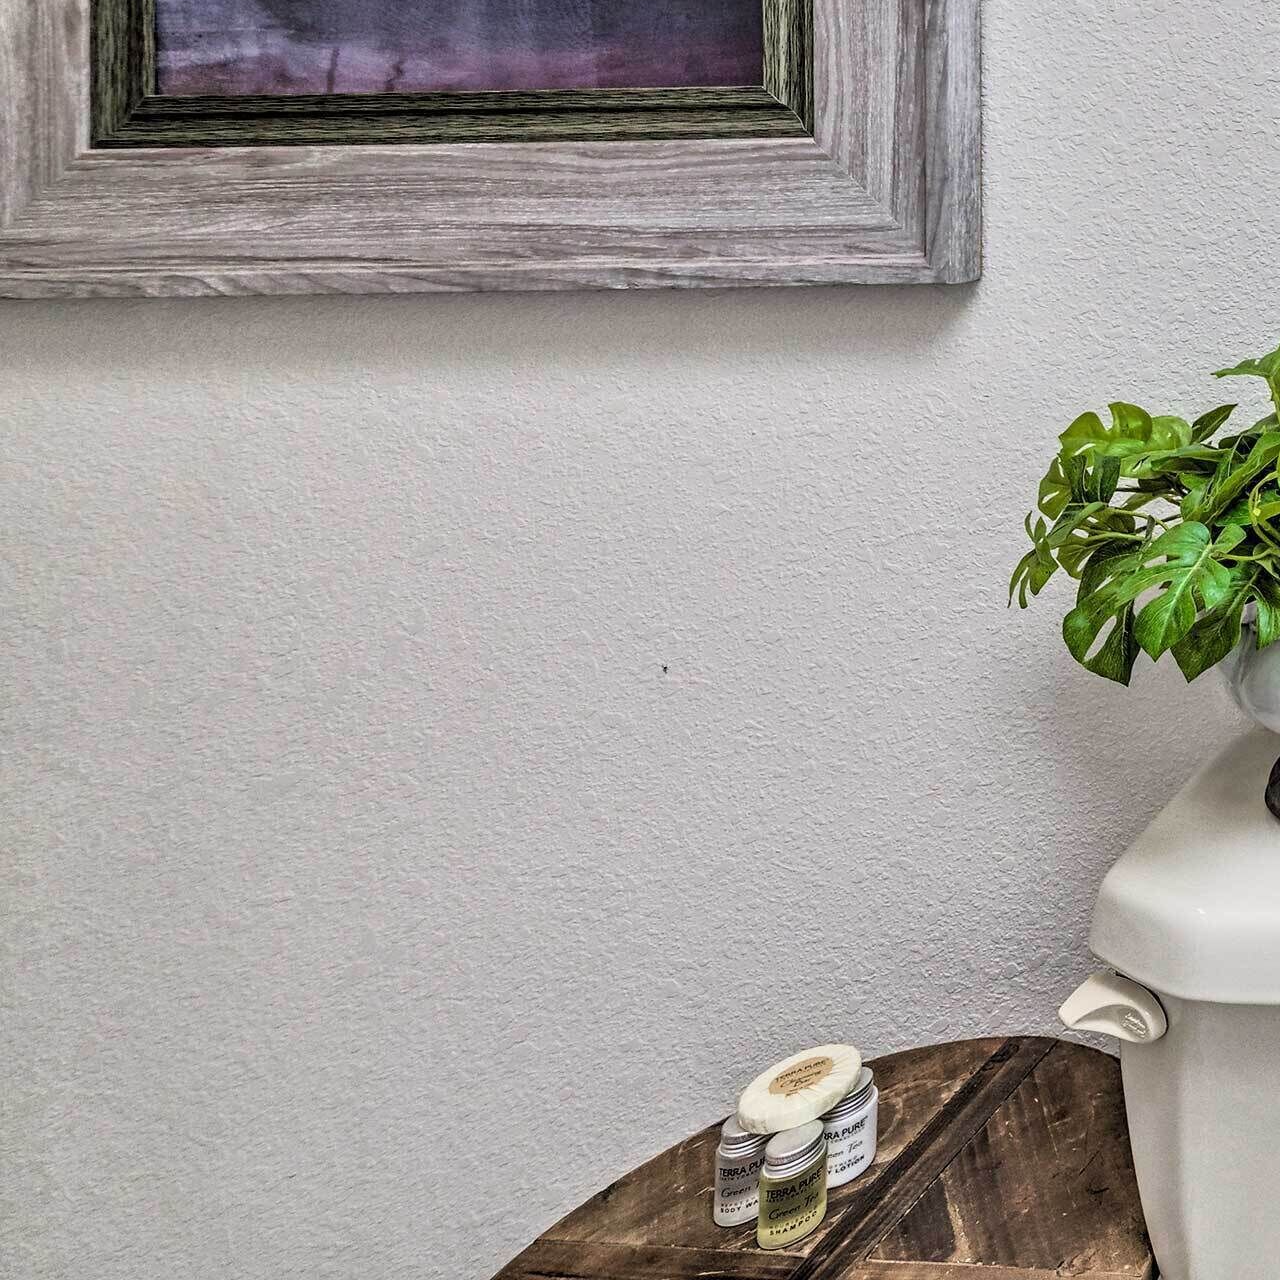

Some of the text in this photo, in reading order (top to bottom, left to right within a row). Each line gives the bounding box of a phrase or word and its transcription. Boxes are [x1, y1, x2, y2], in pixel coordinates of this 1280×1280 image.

[841, 1121, 866, 1137] PURE
[719, 1166, 747, 1177] TERRA
[834, 1154, 865, 1174] LOTION
[766, 1185, 797, 1199] TERRA
[798, 1169, 821, 1191] PURE
[721, 1187, 751, 1198] Green
[768, 1206, 801, 1220] Green
[769, 1210, 818, 1236] SHAMPOO
